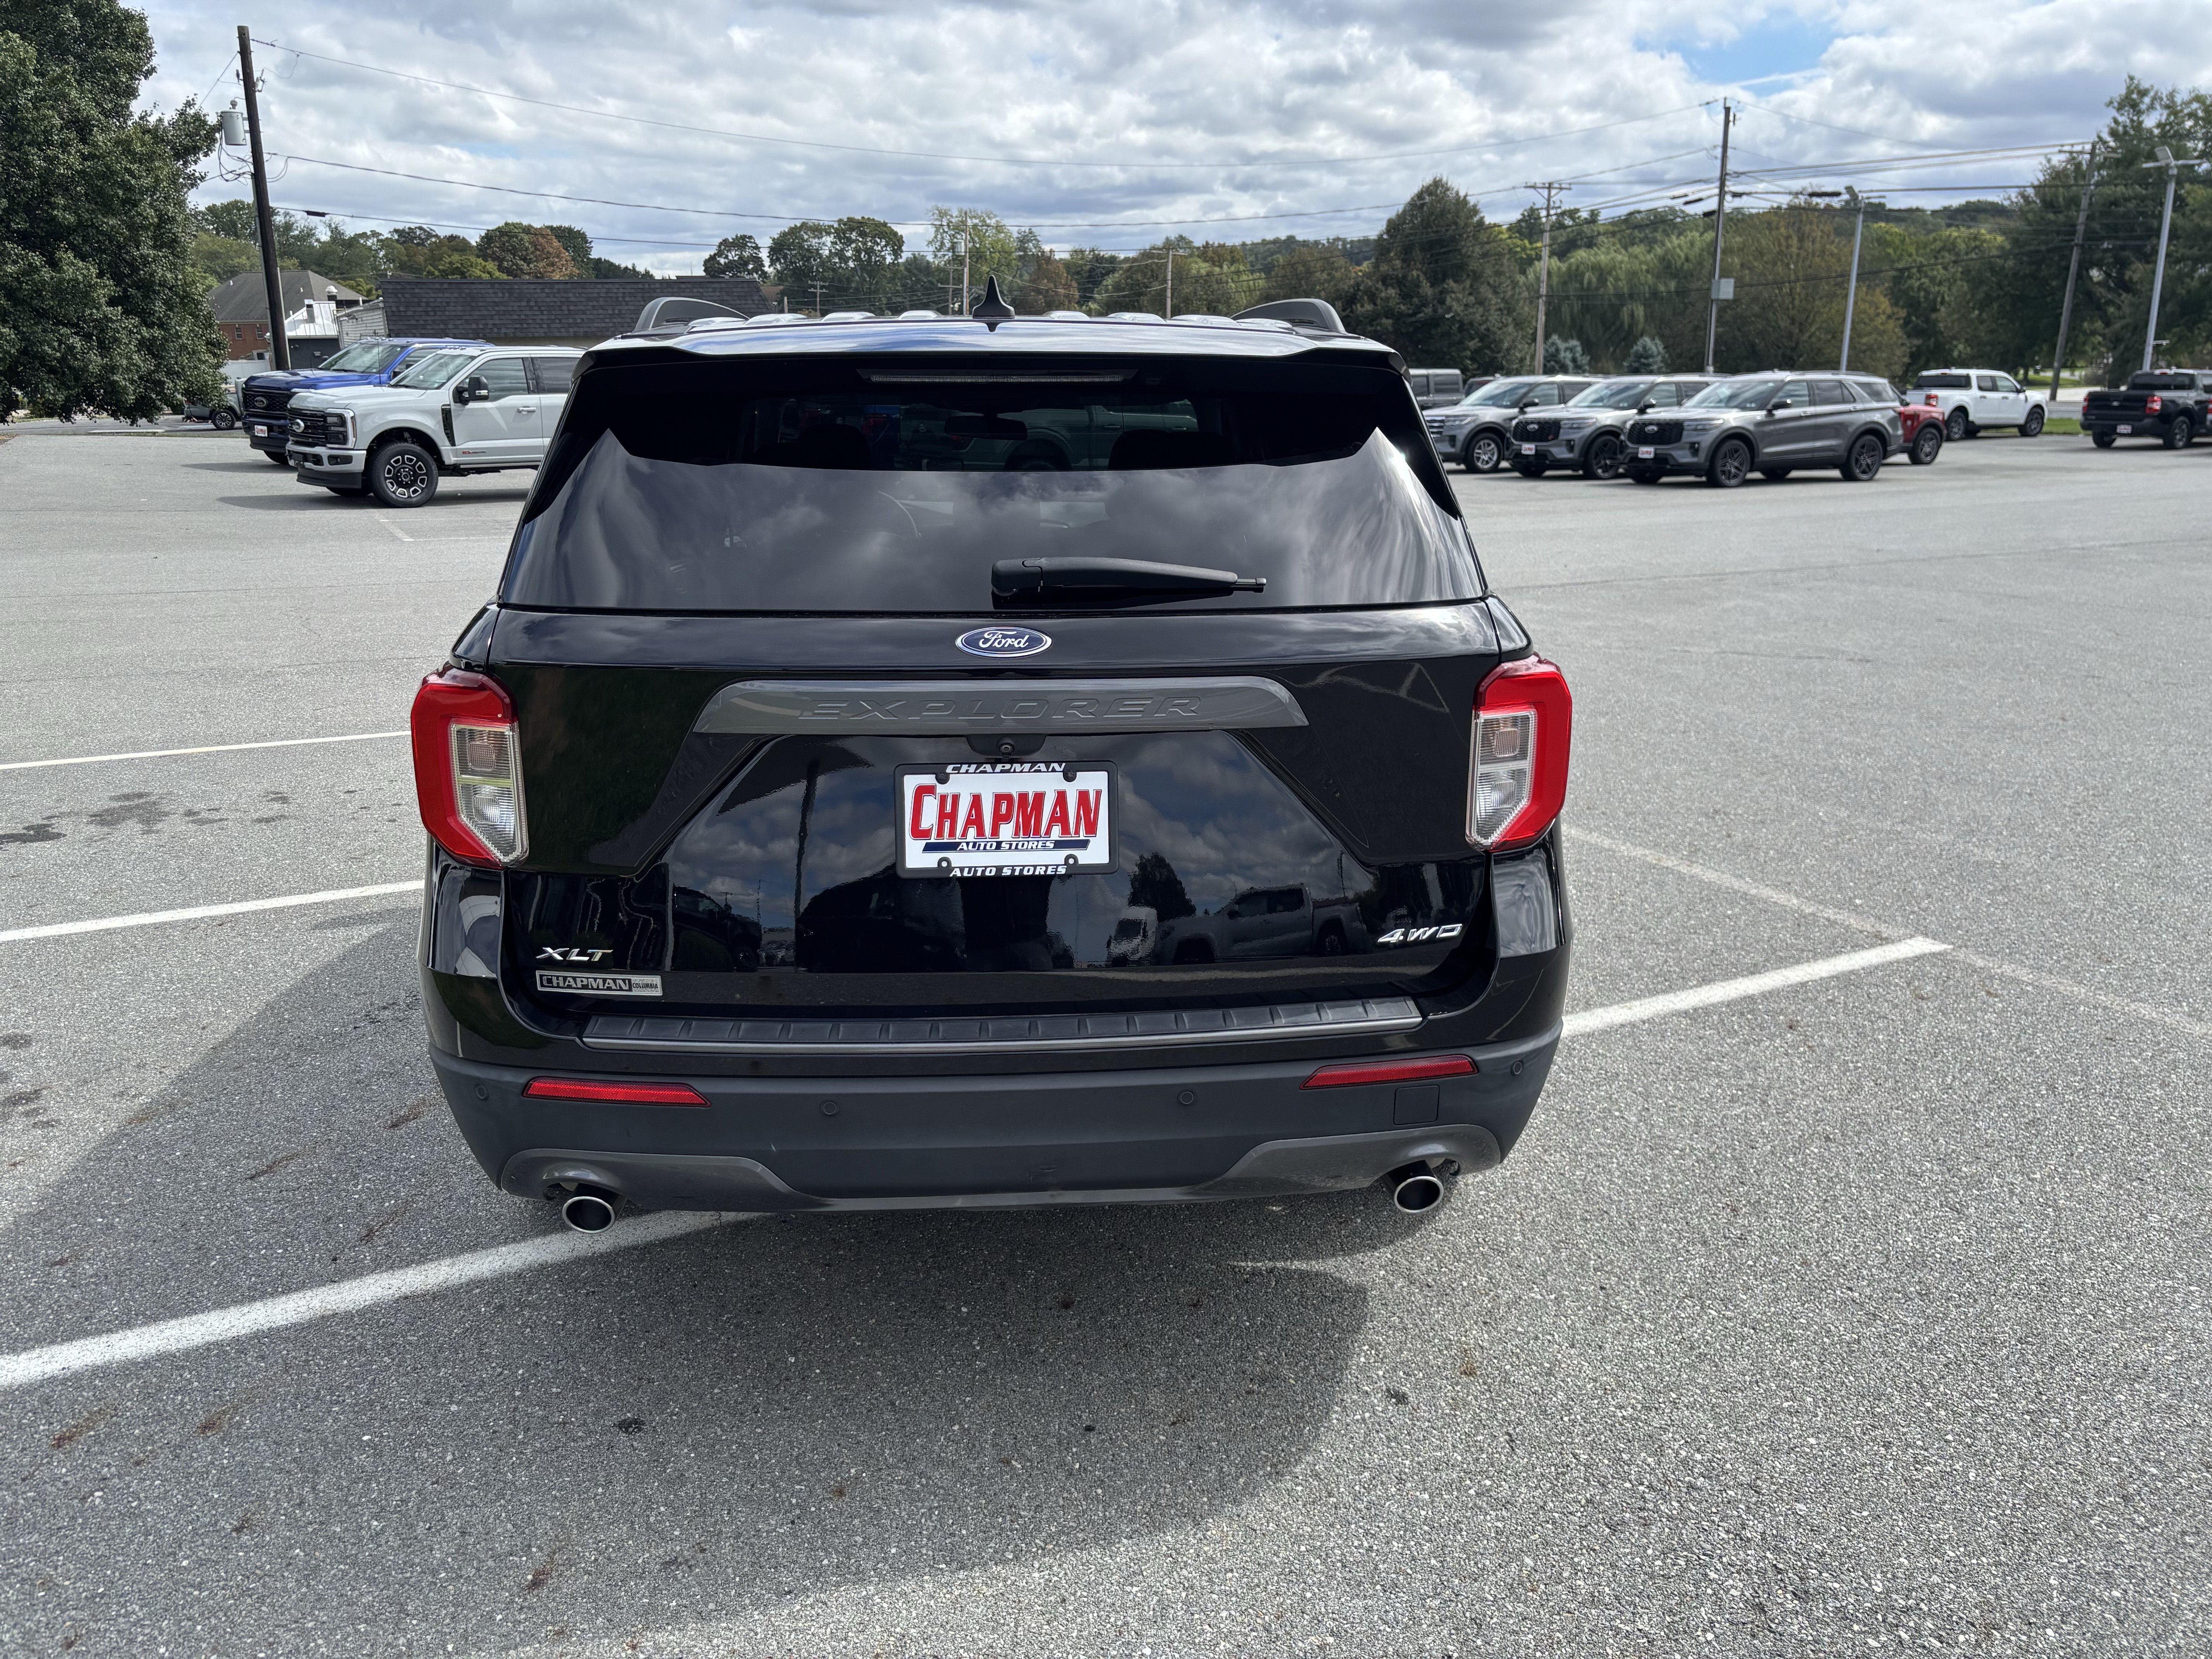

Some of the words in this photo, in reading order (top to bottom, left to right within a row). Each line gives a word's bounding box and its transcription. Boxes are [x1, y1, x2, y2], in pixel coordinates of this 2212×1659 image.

[979, 631, 1029, 647] Ford
[799, 697, 1201, 720] EXPLORER
[946, 763, 1066, 773] CHAPMAN
[909, 783, 1102, 840] CHAPMAN
[957, 842, 996, 851] AUTO
[1000, 840, 1054, 850] STORES
[950, 867, 996, 877] AUTO
[1001, 866, 1067, 876] STORES
[1378, 924, 1463, 943] 4WD
[536, 947, 613, 962] XLT
[543, 976, 630, 990] CHAPMAN
